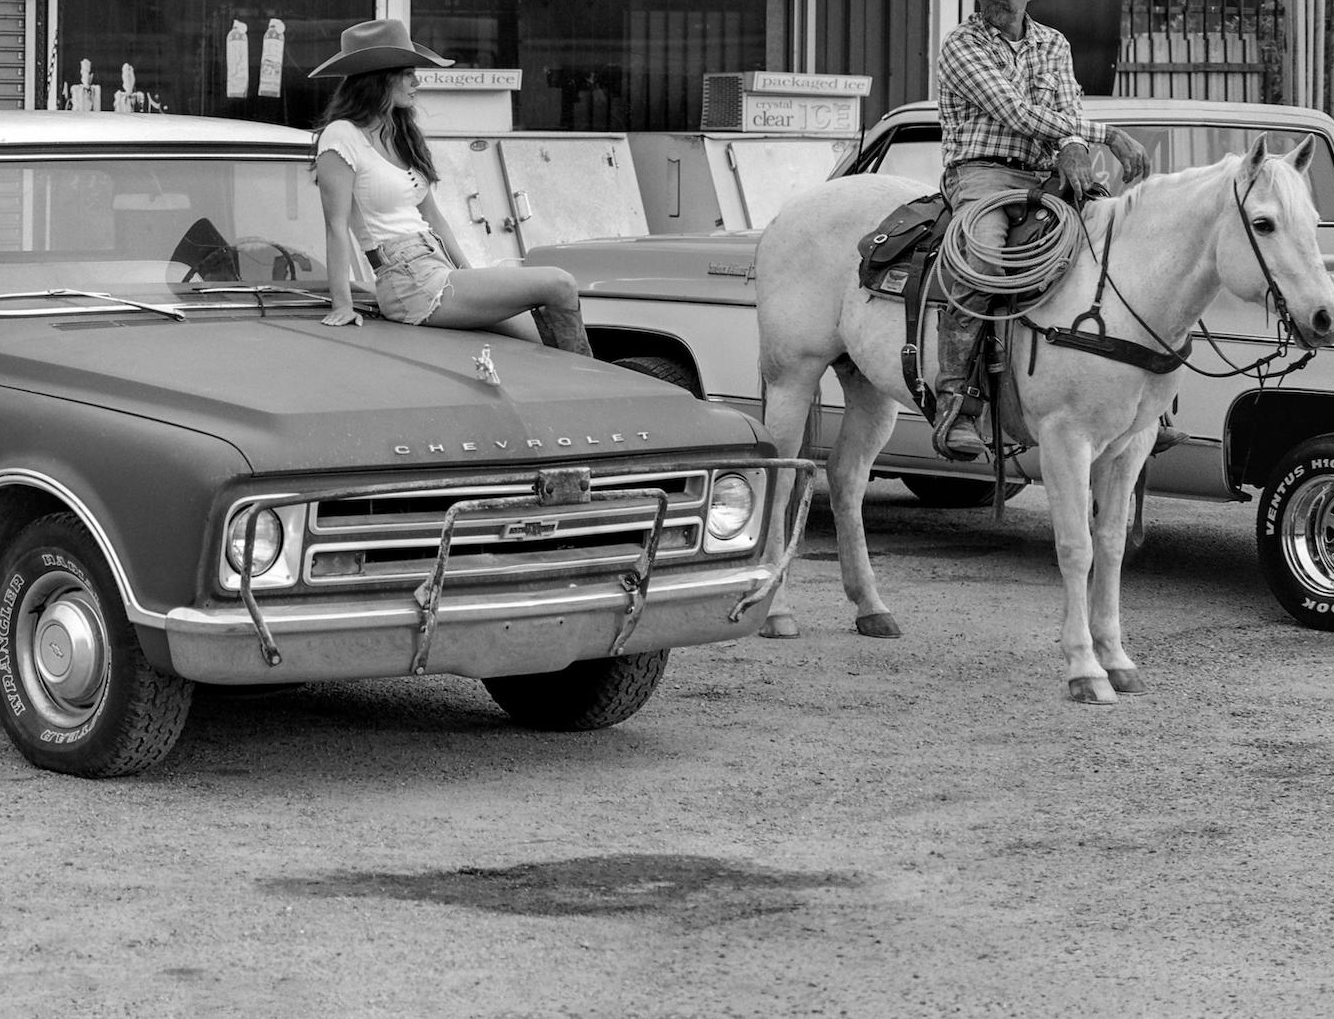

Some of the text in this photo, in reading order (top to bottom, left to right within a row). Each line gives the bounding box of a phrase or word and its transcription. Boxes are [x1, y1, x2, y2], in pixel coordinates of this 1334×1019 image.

[417, 72, 515, 86] ackaged ice
[762, 76, 866, 90] packaged ice
[755, 100, 793, 111] crystal
[753, 111, 794, 127] clear
[394, 431, 653, 455] CHEVROLET
[1266, 464, 1306, 536] VENTUS
